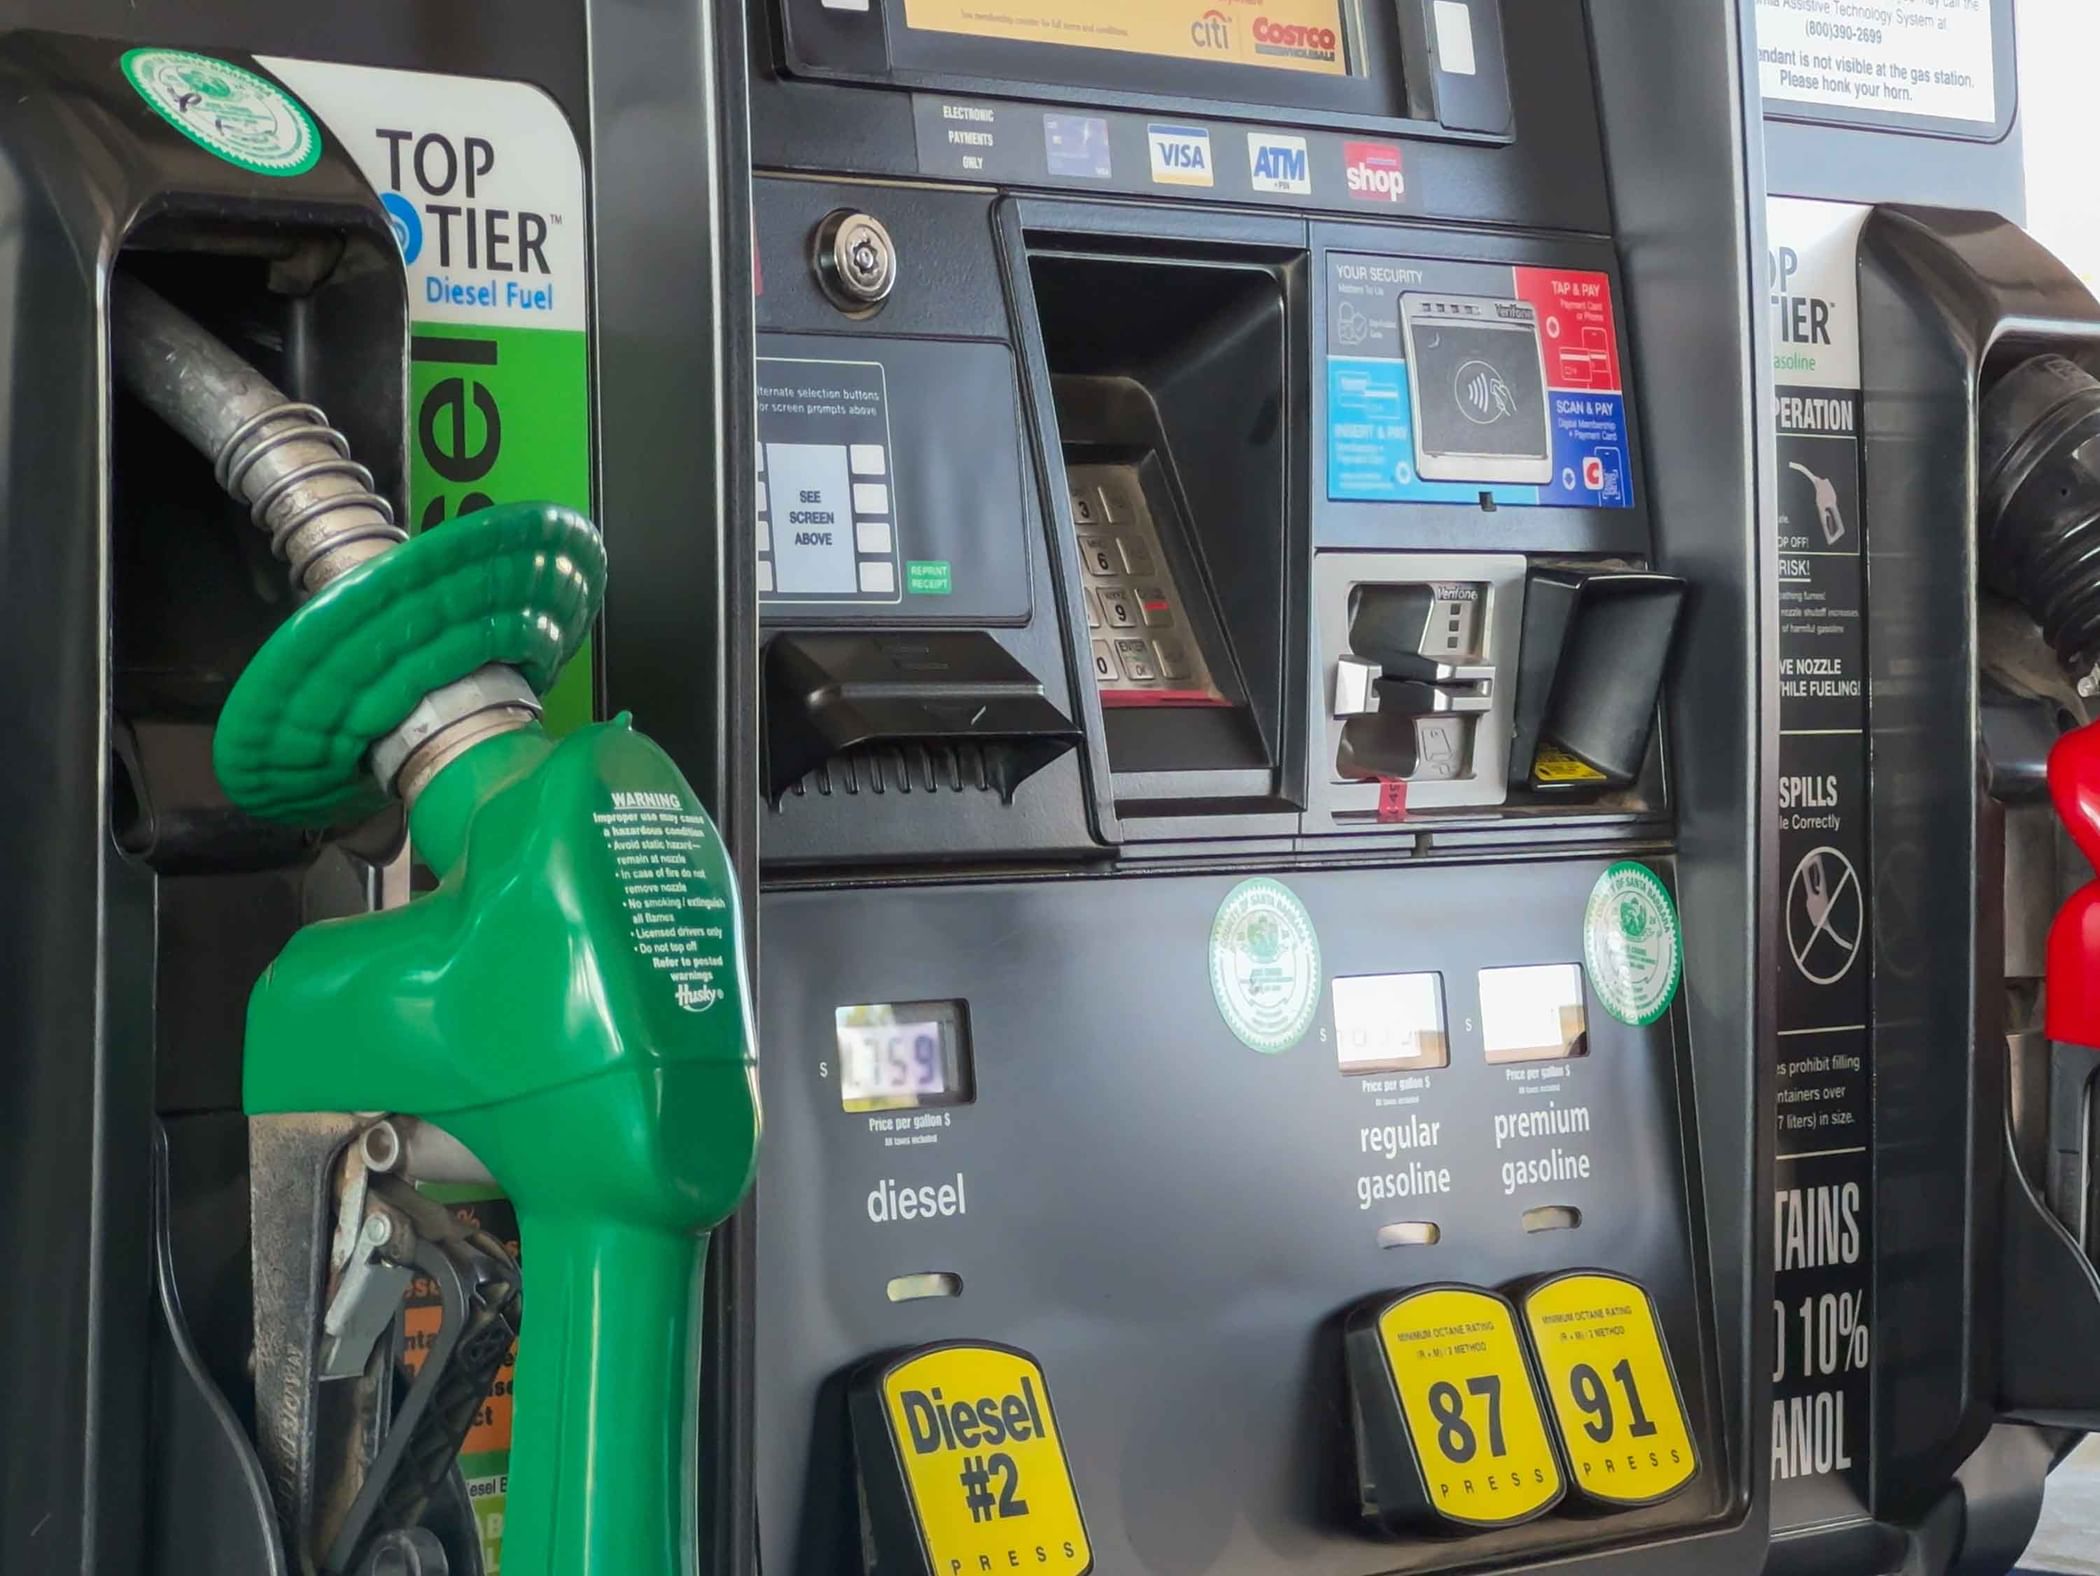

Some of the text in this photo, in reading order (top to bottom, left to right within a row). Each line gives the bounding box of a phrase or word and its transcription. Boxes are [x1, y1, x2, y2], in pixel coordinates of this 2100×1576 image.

[1834, 1, 1892, 26] Technology
[1895, 8, 1934, 28] System
[1937, 17, 1947, 30] at
[1252, 16, 1336, 50] COSTCO
[1805, 20, 1883, 44] (800)390-2699
[1800, 53, 1975, 88] is not visible at the gas station.
[1780, 70, 1913, 101] Please honk your horn.
[943, 105, 994, 122] ELECTRONIC
[376, 128, 495, 198] TOP
[948, 130, 1305, 181] PAYMENTS VISA ATM
[962, 156, 1405, 202] ONLY shop
[1337, 264, 1424, 285] YOUR SECURITY
[426, 276, 552, 310] Diesel Fuel
[1552, 281, 1570, 296] TAP
[1582, 283, 1600, 297] PAY
[797, 388, 880, 401] selection buttons
[772, 403, 805, 413] screen
[807, 404, 846, 415] prompts
[849, 406, 877, 416] above
[1557, 400, 1584, 415] SCAN
[1595, 402, 1614, 416] PAY
[800, 491, 821, 504] SEE
[789, 511, 834, 524] SCREEN
[1078, 501, 1090, 519] 3
[795, 532, 832, 546] ABOVE
[1097, 552, 1109, 571] 6
[1779, 559, 1810, 577] RISK!
[1115, 604, 1127, 622] 9
[1796, 659, 1842, 675] NOZZLE
[1779, 681, 1861, 697] HILE FUELING!
[611, 791, 681, 809] WARNING
[1779, 775, 1838, 809] SPILLS
[593, 811, 638, 824] Improper
[640, 813, 658, 822] use
[659, 813, 678, 825] may
[1792, 813, 1841, 832] Correctly
[612, 826, 664, 836] hazardous
[665, 826, 705, 837] condition
[614, 840, 665, 851] Avoid static
[617, 854, 687, 866] remain at nozzle
[633, 870, 654, 879] case
[655, 867, 664, 878] of
[664, 867, 679, 878] fire
[681, 867, 692, 878] do
[624, 882, 688, 895] remove nozzle
[628, 898, 643, 909] No
[644, 898, 683, 910] smoking
[633, 912, 675, 925] all flames
[635, 926, 723, 940] Licensed drivers only
[639, 940, 698, 954] Do not top off
[653, 955, 724, 969] Refer to posted
[670, 971, 714, 983] warnings
[675, 983, 717, 1008] Husky
[1506, 1065, 1563, 1081] Price per gallon
[1788, 1054, 1860, 1078] prohibit filling
[1362, 1076, 1423, 1093] Price per gallon
[1777, 1085, 1846, 1103] ntainers over
[868, 1117, 894, 1132] Price
[895, 1117, 911, 1131] per
[913, 1113, 942, 1130] gallon
[1494, 1100, 1590, 1149] premium
[1786, 1111, 1817, 1131] liters)
[1819, 1110, 1829, 1126] in
[1831, 1109, 1855, 1125] size.
[1360, 1114, 1440, 1160] regular
[1502, 1148, 1591, 1195] gasoline
[1357, 1161, 1451, 1211] gasoline
[867, 1172, 966, 1223] diesel
[1773, 1181, 1861, 1273] TAINS
[1575, 1308, 1604, 1321] OCTANE
[1605, 1305, 1632, 1316] RATING
[1397, 1321, 1495, 1342] MINIMUM OCTANE RATING
[1594, 1325, 1625, 1338] METHOD
[1799, 1287, 1869, 1378] 10%
[1454, 1341, 1487, 1354] METHOD
[1570, 1358, 1658, 1445] 91
[899, 1375, 1046, 1455] Diesel
[1428, 1374, 1507, 1465] 87
[1771, 1390, 1851, 1482] ANOL
[960, 1452, 1030, 1524] #2
